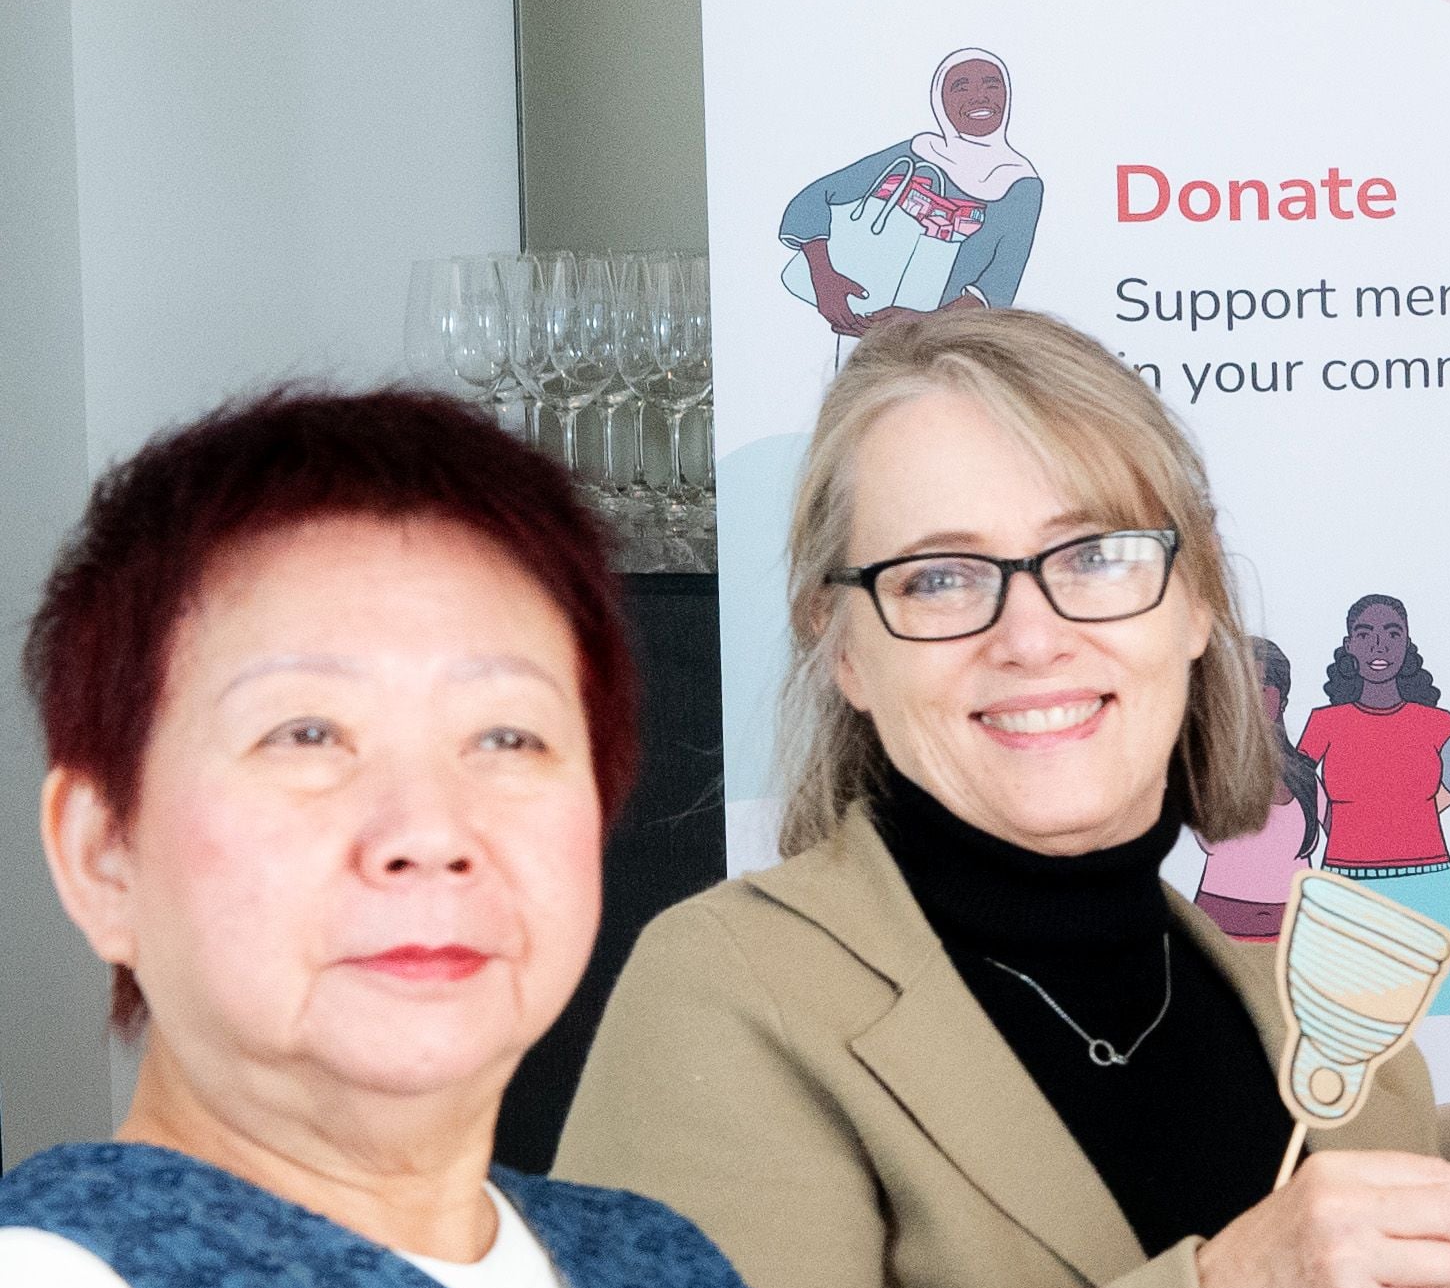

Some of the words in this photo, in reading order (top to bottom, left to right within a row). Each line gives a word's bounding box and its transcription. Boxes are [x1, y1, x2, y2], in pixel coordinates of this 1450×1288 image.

[1117, 165, 1396, 222] Donate
[1117, 278, 1337, 331] Support
[1118, 352, 1161, 393] n
[1182, 361, 1298, 404] your
